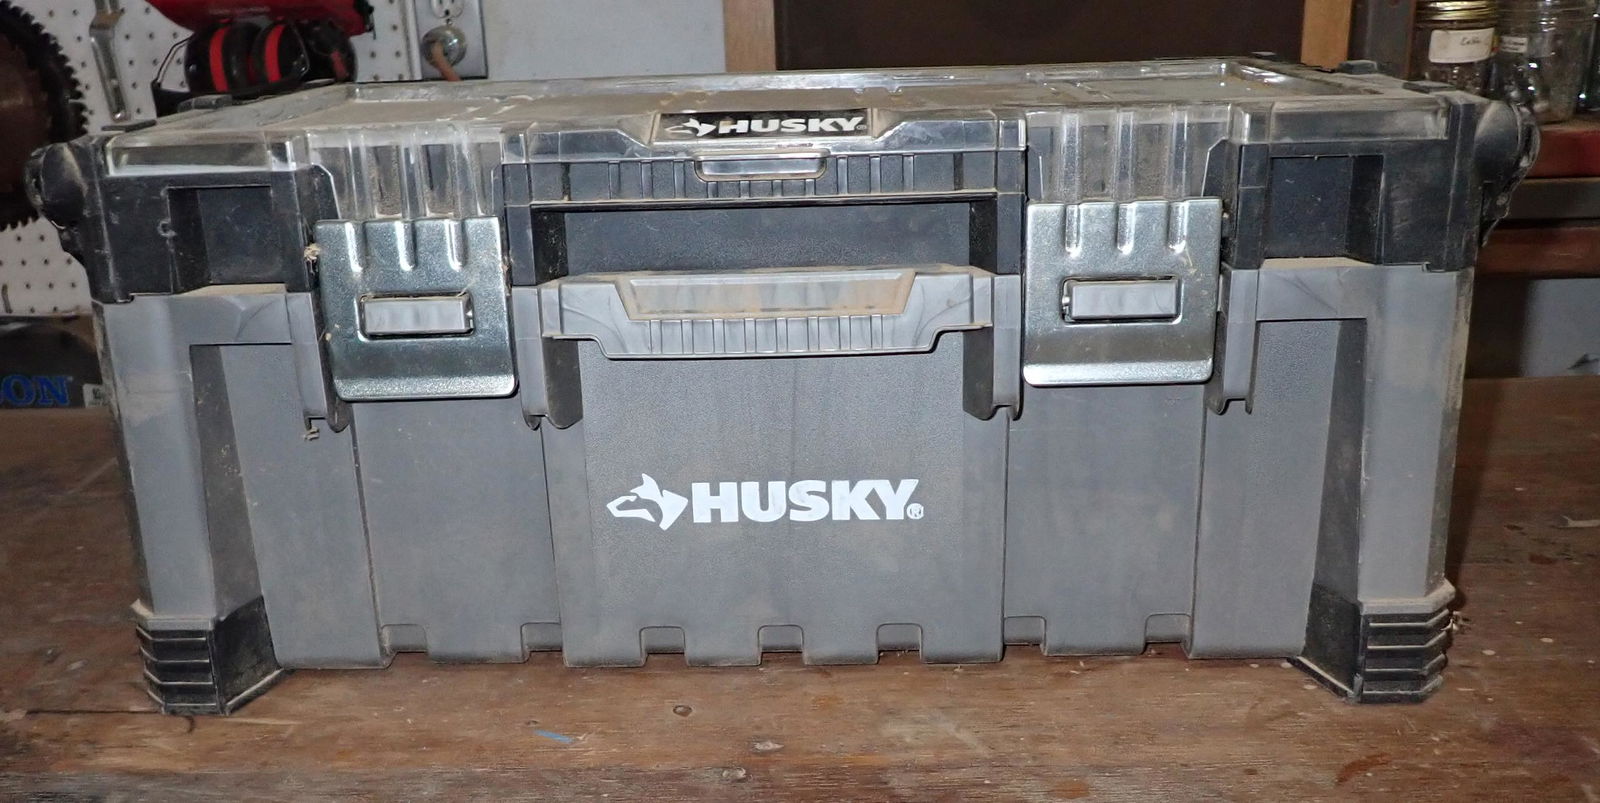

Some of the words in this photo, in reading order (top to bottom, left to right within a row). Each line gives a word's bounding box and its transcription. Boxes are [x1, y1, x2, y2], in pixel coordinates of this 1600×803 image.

[718, 116, 864, 134] HUSKY
[0, 374, 69, 405] ON
[691, 478, 919, 523] HUSKY
